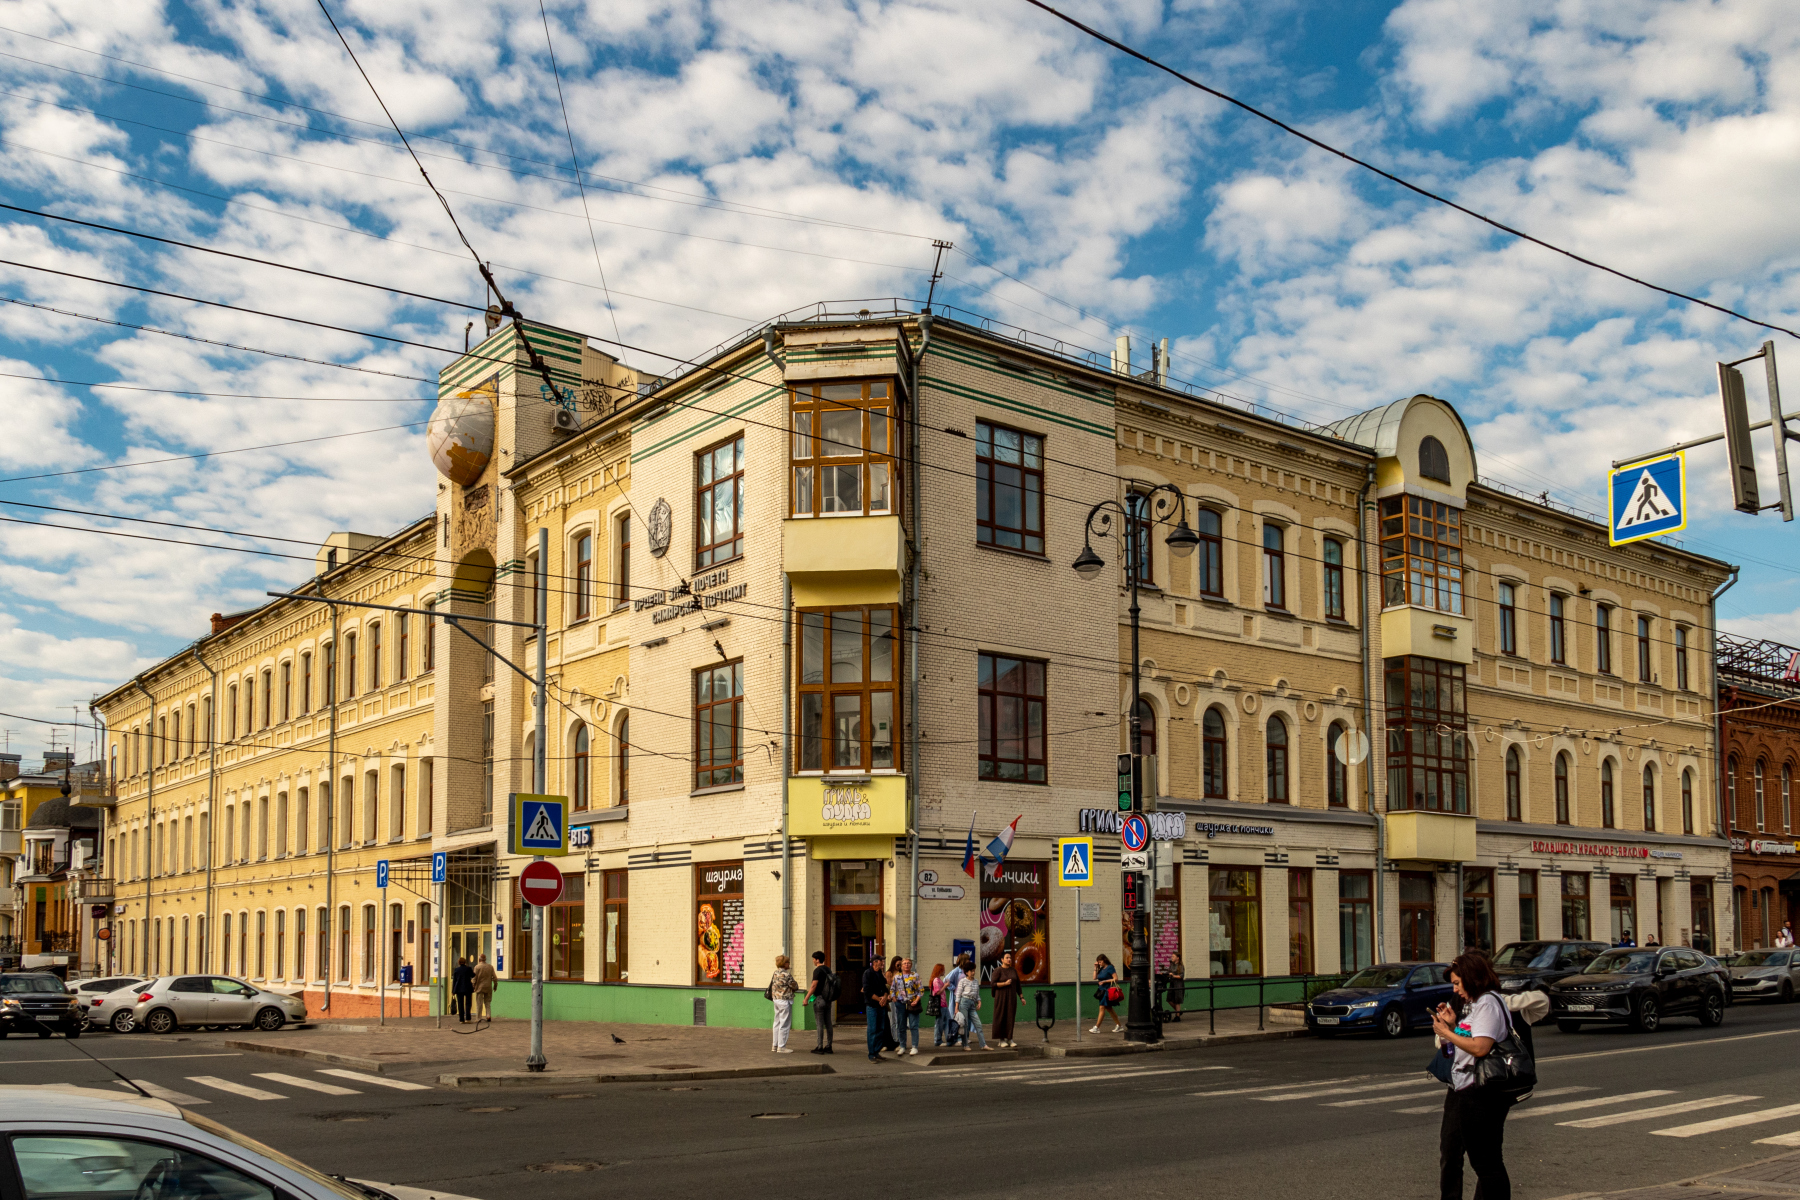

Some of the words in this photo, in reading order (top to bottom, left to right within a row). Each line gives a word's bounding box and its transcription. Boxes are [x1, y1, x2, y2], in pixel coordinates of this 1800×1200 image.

[634, 591, 666, 612] ОРДЕНА
[694, 569, 729, 592] ПОЧЕТА
[703, 583, 747, 608] ПОЧТАМТ
[823, 787, 862, 804] ГРИЛЬ
[822, 802, 871, 822] ПУДРА
[1080, 808, 1123, 834] ГРИЛЬ
[1147, 812, 1186, 841] УДРА
[1196, 821, 1230, 838] шаурма
[1232, 824, 1239, 833] и
[1240, 822, 1275, 836] пончики
[571, 828, 589, 845] ВТБ
[1531, 840, 1574, 855] БОЛЬШОЕ
[1577, 843, 1614, 857] КРАСНОЕ
[705, 868, 743, 892] шаурма
[924, 872, 933, 881] 82
